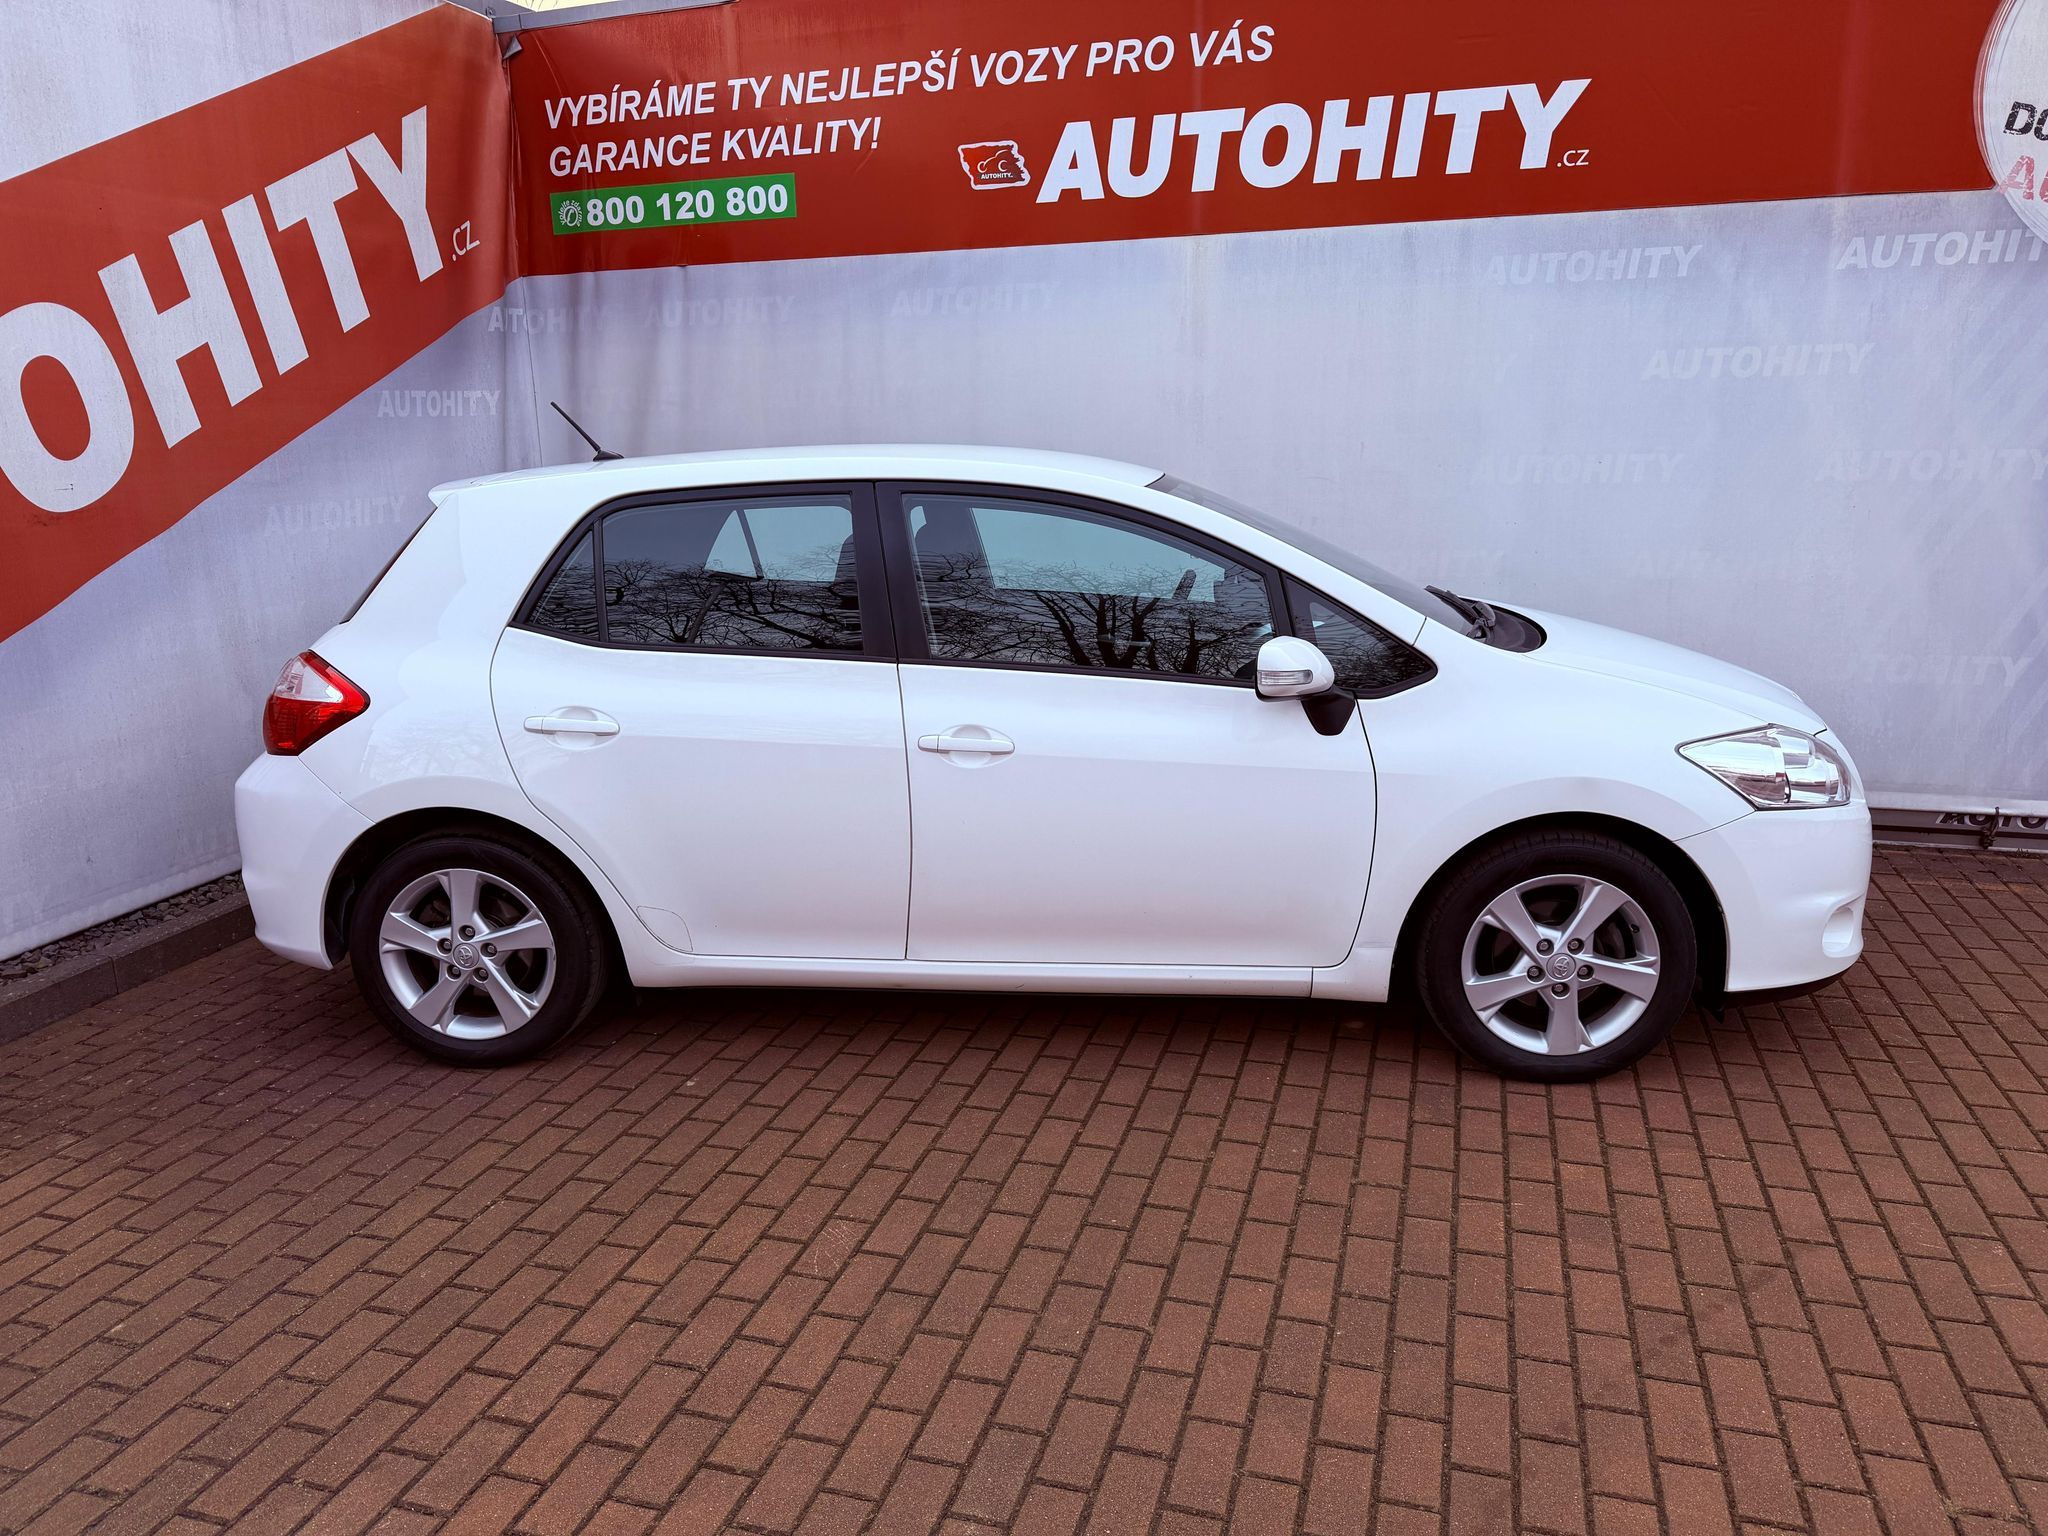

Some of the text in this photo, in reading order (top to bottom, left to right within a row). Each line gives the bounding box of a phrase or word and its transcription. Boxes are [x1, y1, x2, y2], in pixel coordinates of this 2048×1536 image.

[544, 19, 1275, 129] VYBÍRÁME TY NEJLEPŠÍ VOZY PRO VÁS
[549, 116, 882, 177] GARANCE KVALITY!
[586, 184, 788, 226] 800 120 800
[1482, 244, 1704, 286] AUTOHITY
[1641, 342, 1876, 382] AUTOHITY
[377, 389, 501, 418] AUTOHITY
